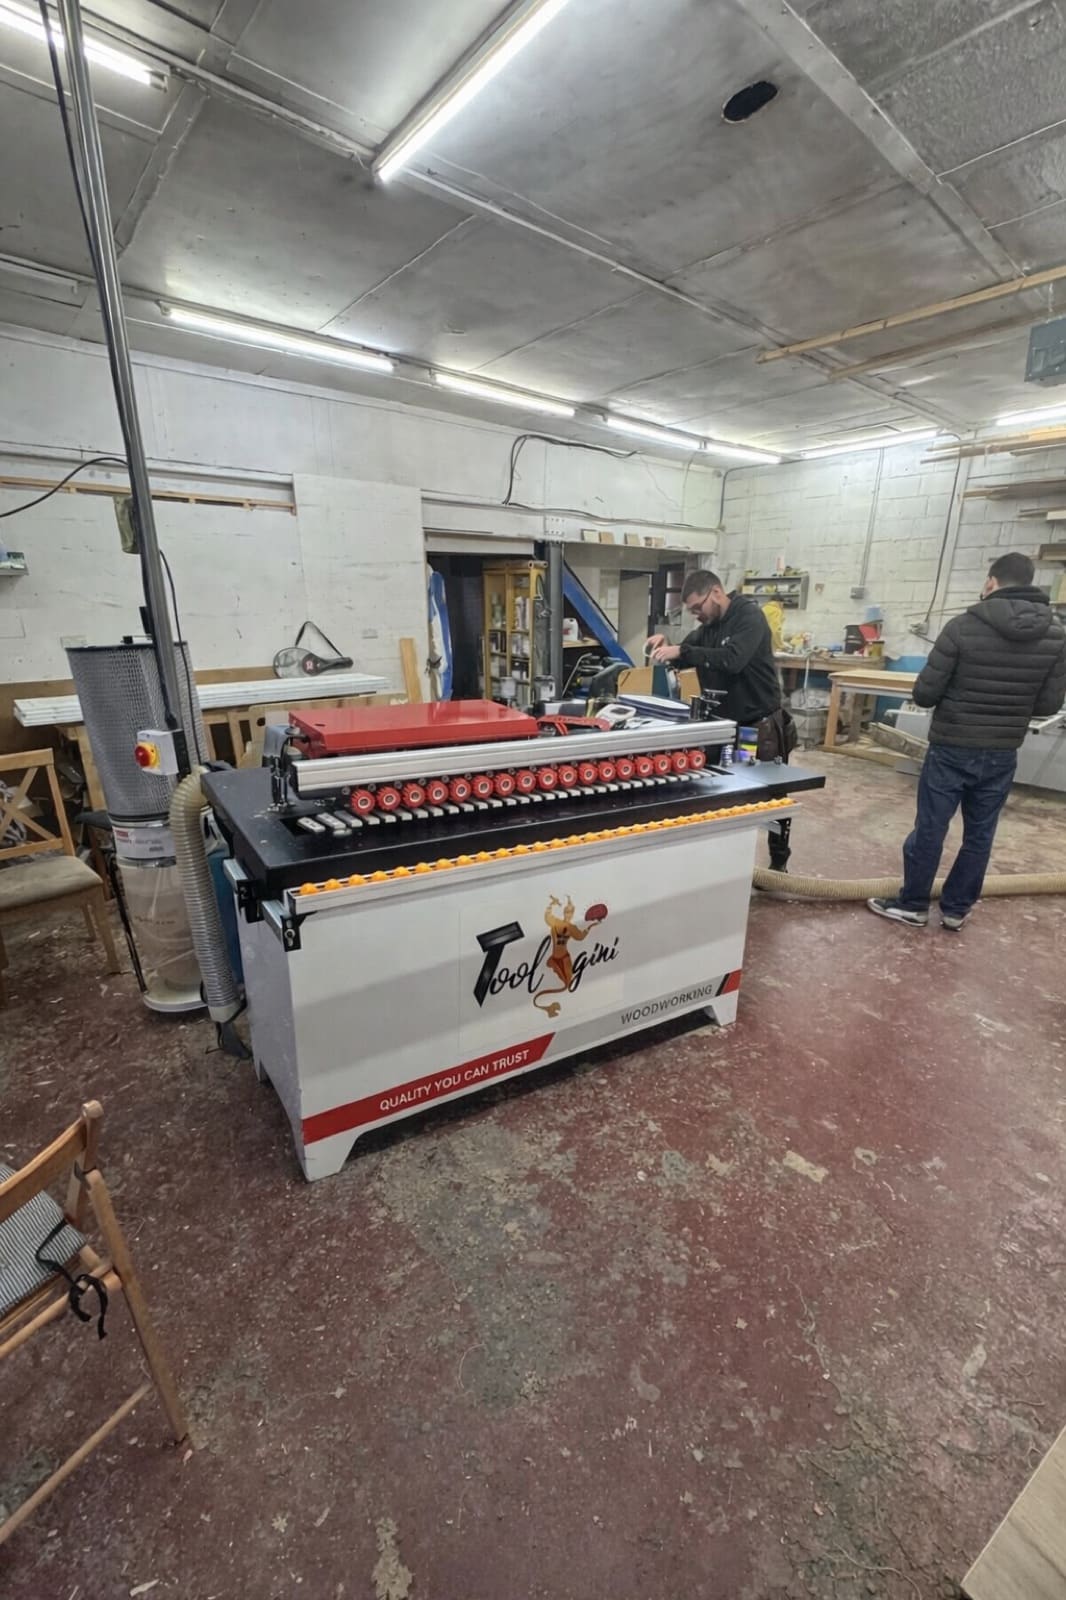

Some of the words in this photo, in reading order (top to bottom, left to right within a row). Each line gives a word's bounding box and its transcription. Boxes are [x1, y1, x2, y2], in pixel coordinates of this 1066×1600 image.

[473, 921, 551, 1008] Tool
[568, 937, 620, 993] gini
[621, 984, 713, 1025] WOODWORKING
[379, 1084, 432, 1111] QUALITY
[434, 1073, 461, 1092] YOU
[464, 1063, 490, 1081] CAN
[492, 1049, 530, 1071] TRUST
